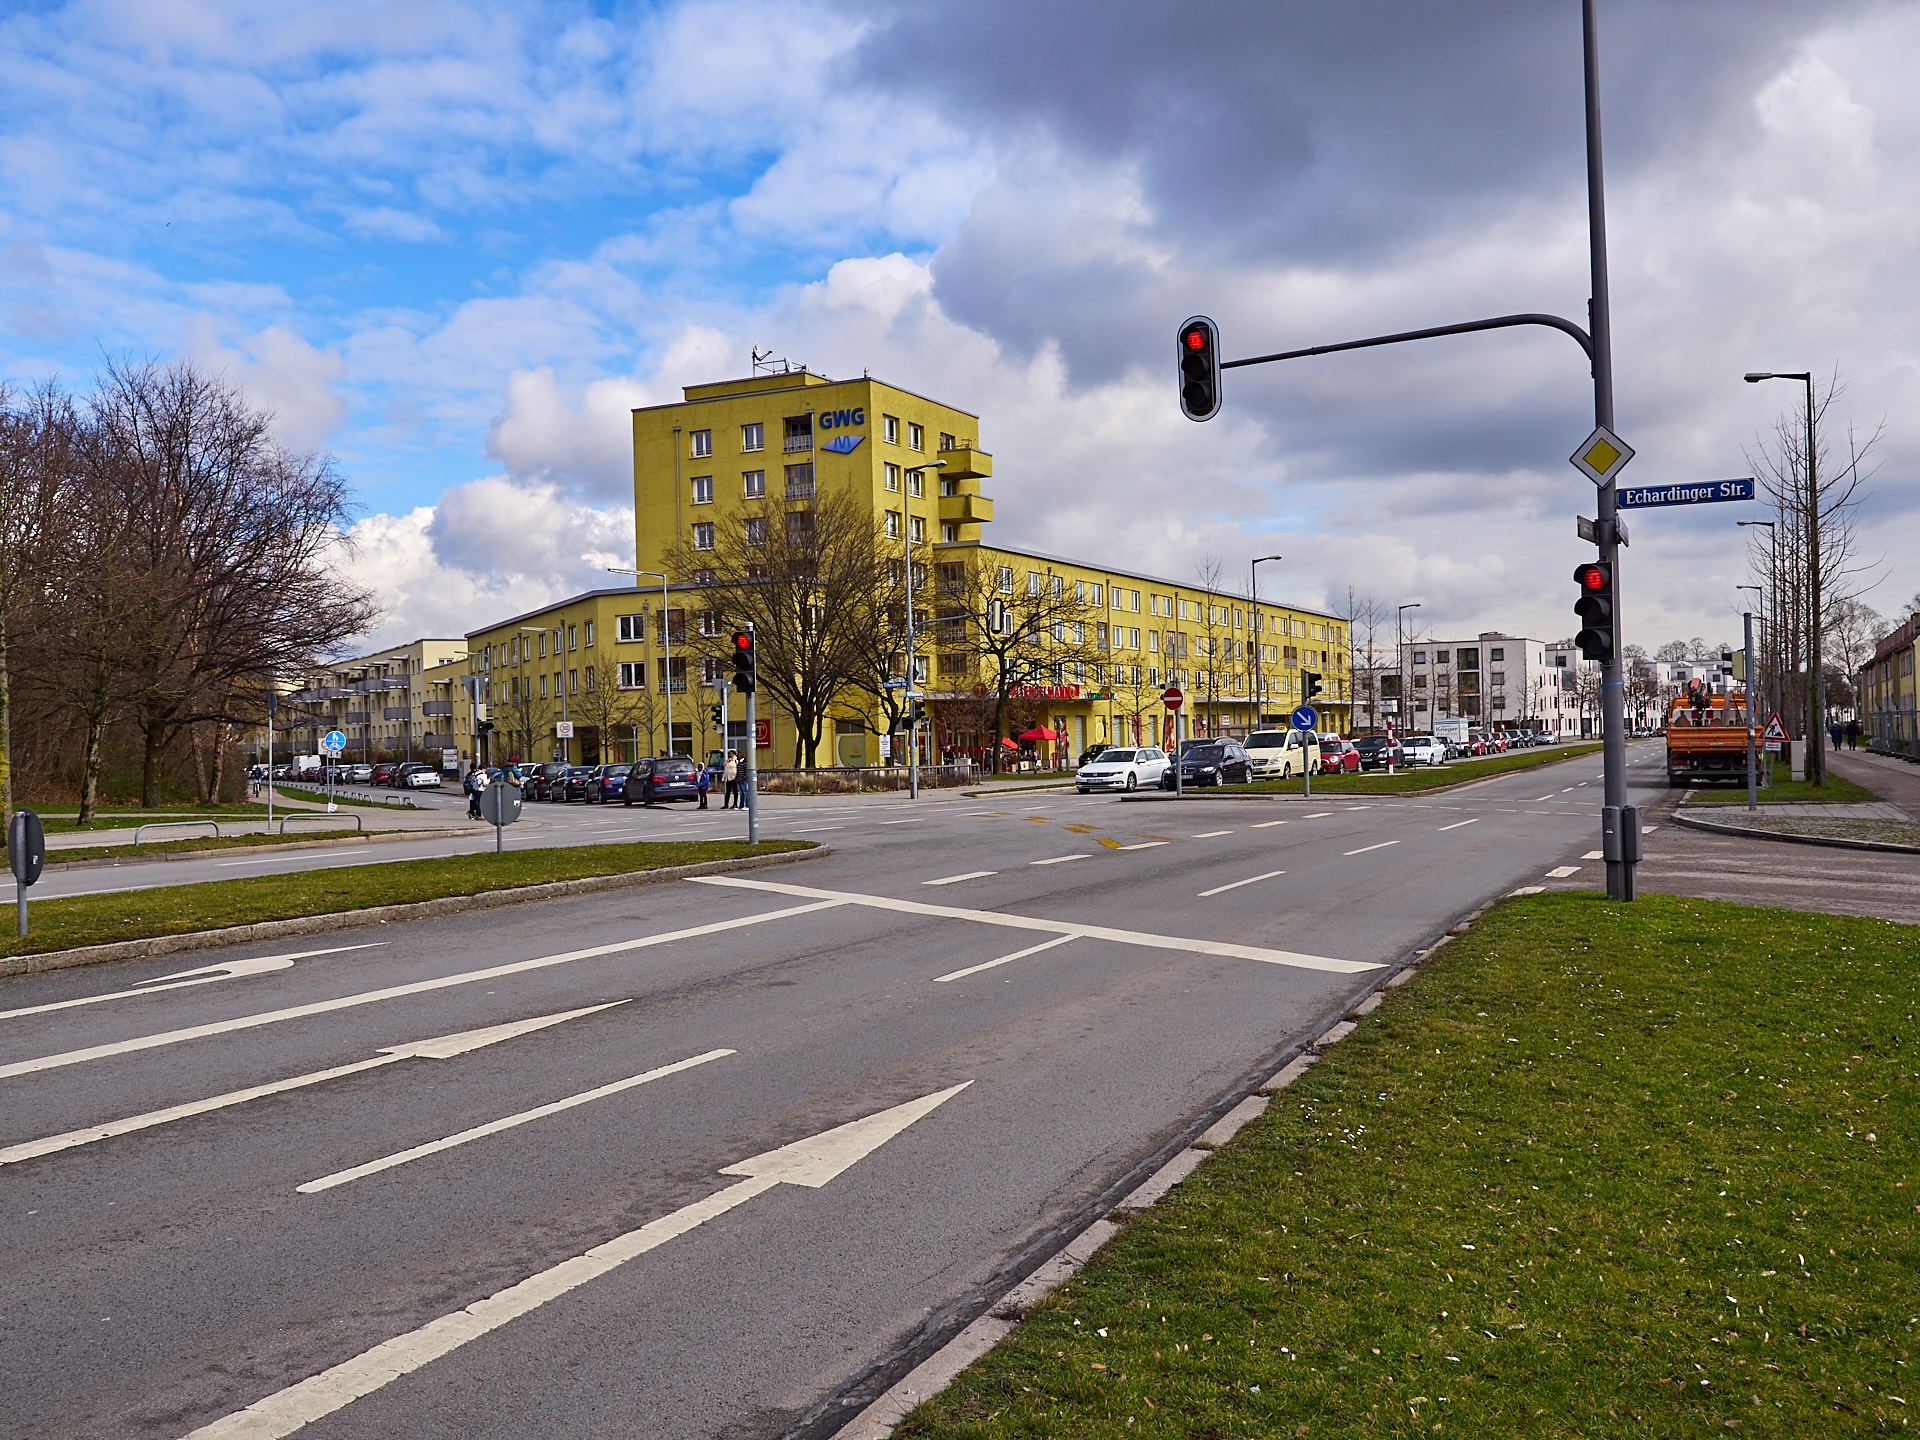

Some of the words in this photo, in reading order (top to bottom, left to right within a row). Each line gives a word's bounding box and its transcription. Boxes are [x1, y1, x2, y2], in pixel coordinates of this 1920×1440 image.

[819, 407, 864, 429] GWG
[1625, 487, 1715, 505] Echardinger
[1720, 482, 1746, 498] Str.
[756, 725, 765, 737] T
